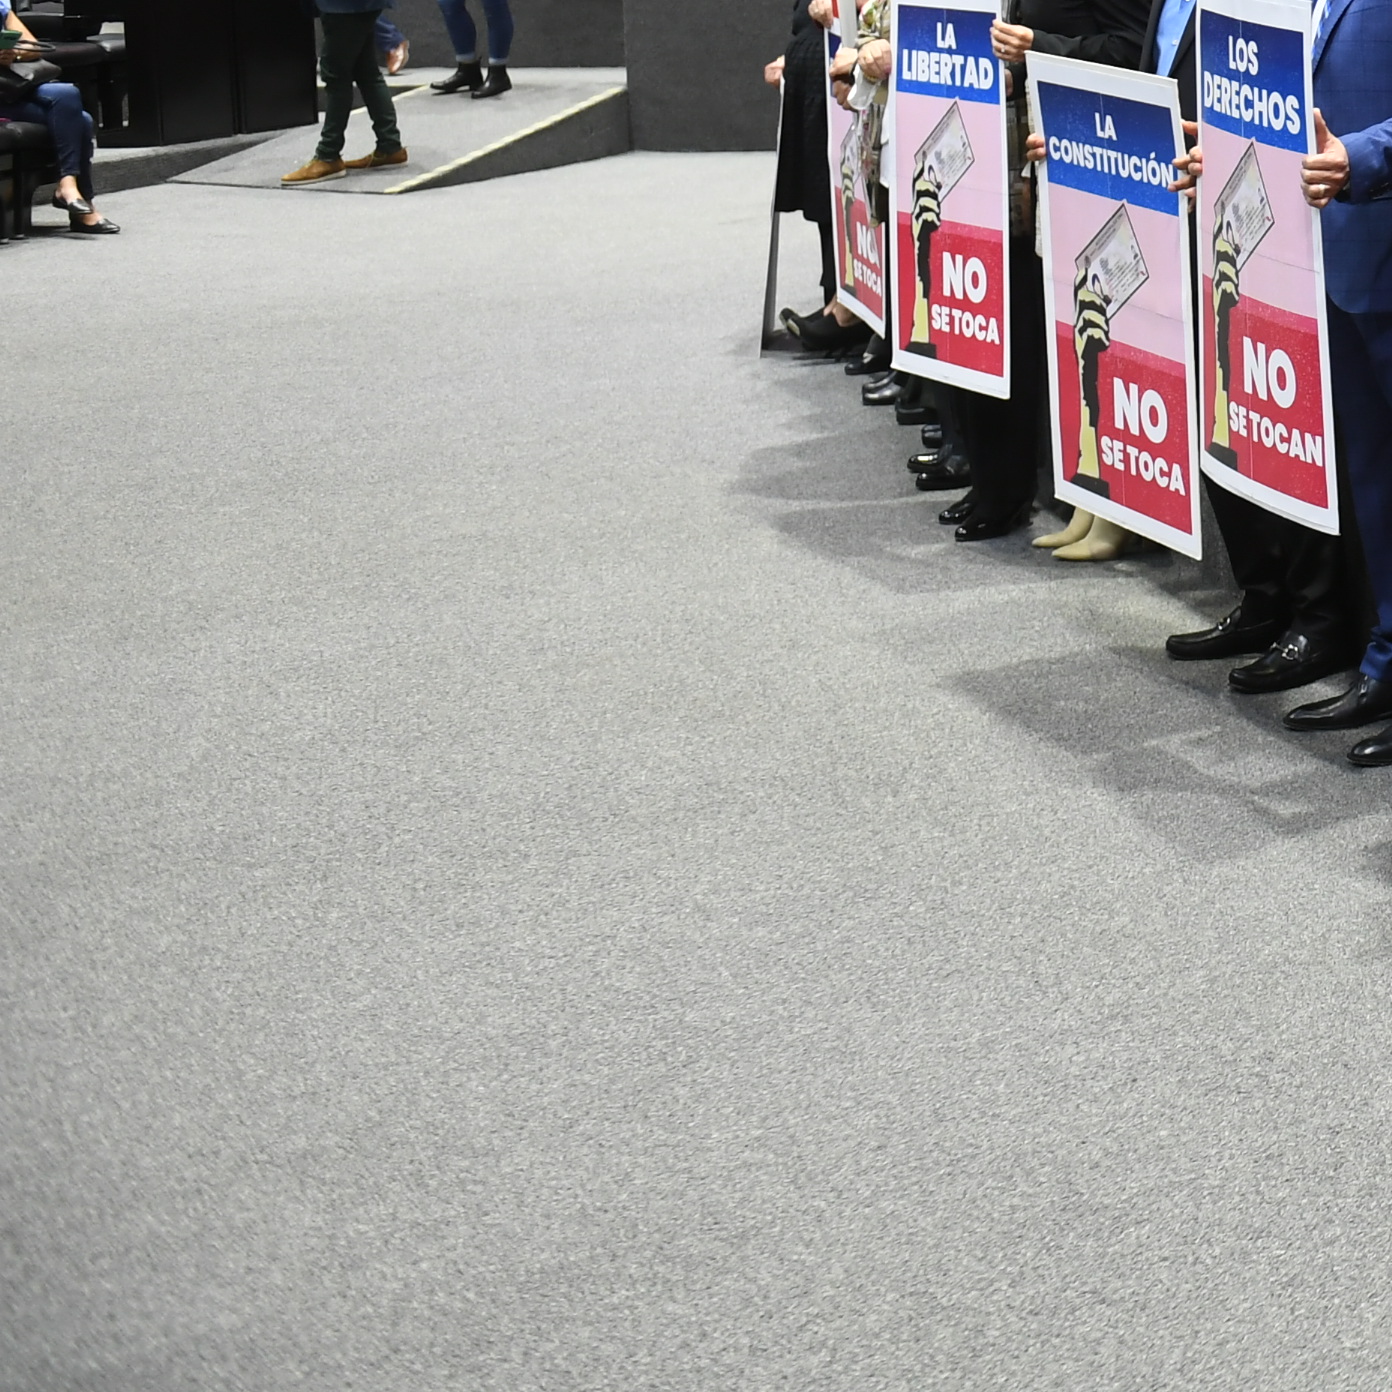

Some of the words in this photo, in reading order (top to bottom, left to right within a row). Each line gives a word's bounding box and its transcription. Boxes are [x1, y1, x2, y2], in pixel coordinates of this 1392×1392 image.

[937, 22, 956, 49] LA
[1229, 36, 1258, 75] LOS
[903, 49, 993, 89] LIBERTAD
[1095, 113, 1117, 140] LA
[1203, 73, 1300, 135] DERECHOS
[1048, 136, 1174, 188] CONSTITUCIÓN
[943, 252, 987, 303] NO
[931, 304, 956, 333] SE
[955, 310, 1000, 345] TOCA
[1243, 336, 1296, 408] NO
[1114, 377, 1167, 443] NO
[1229, 401, 1253, 434] SE
[1248, 411, 1324, 468] TOCAN
[1100, 435, 1126, 472] SE
[1125, 444, 1186, 497] TOCA
